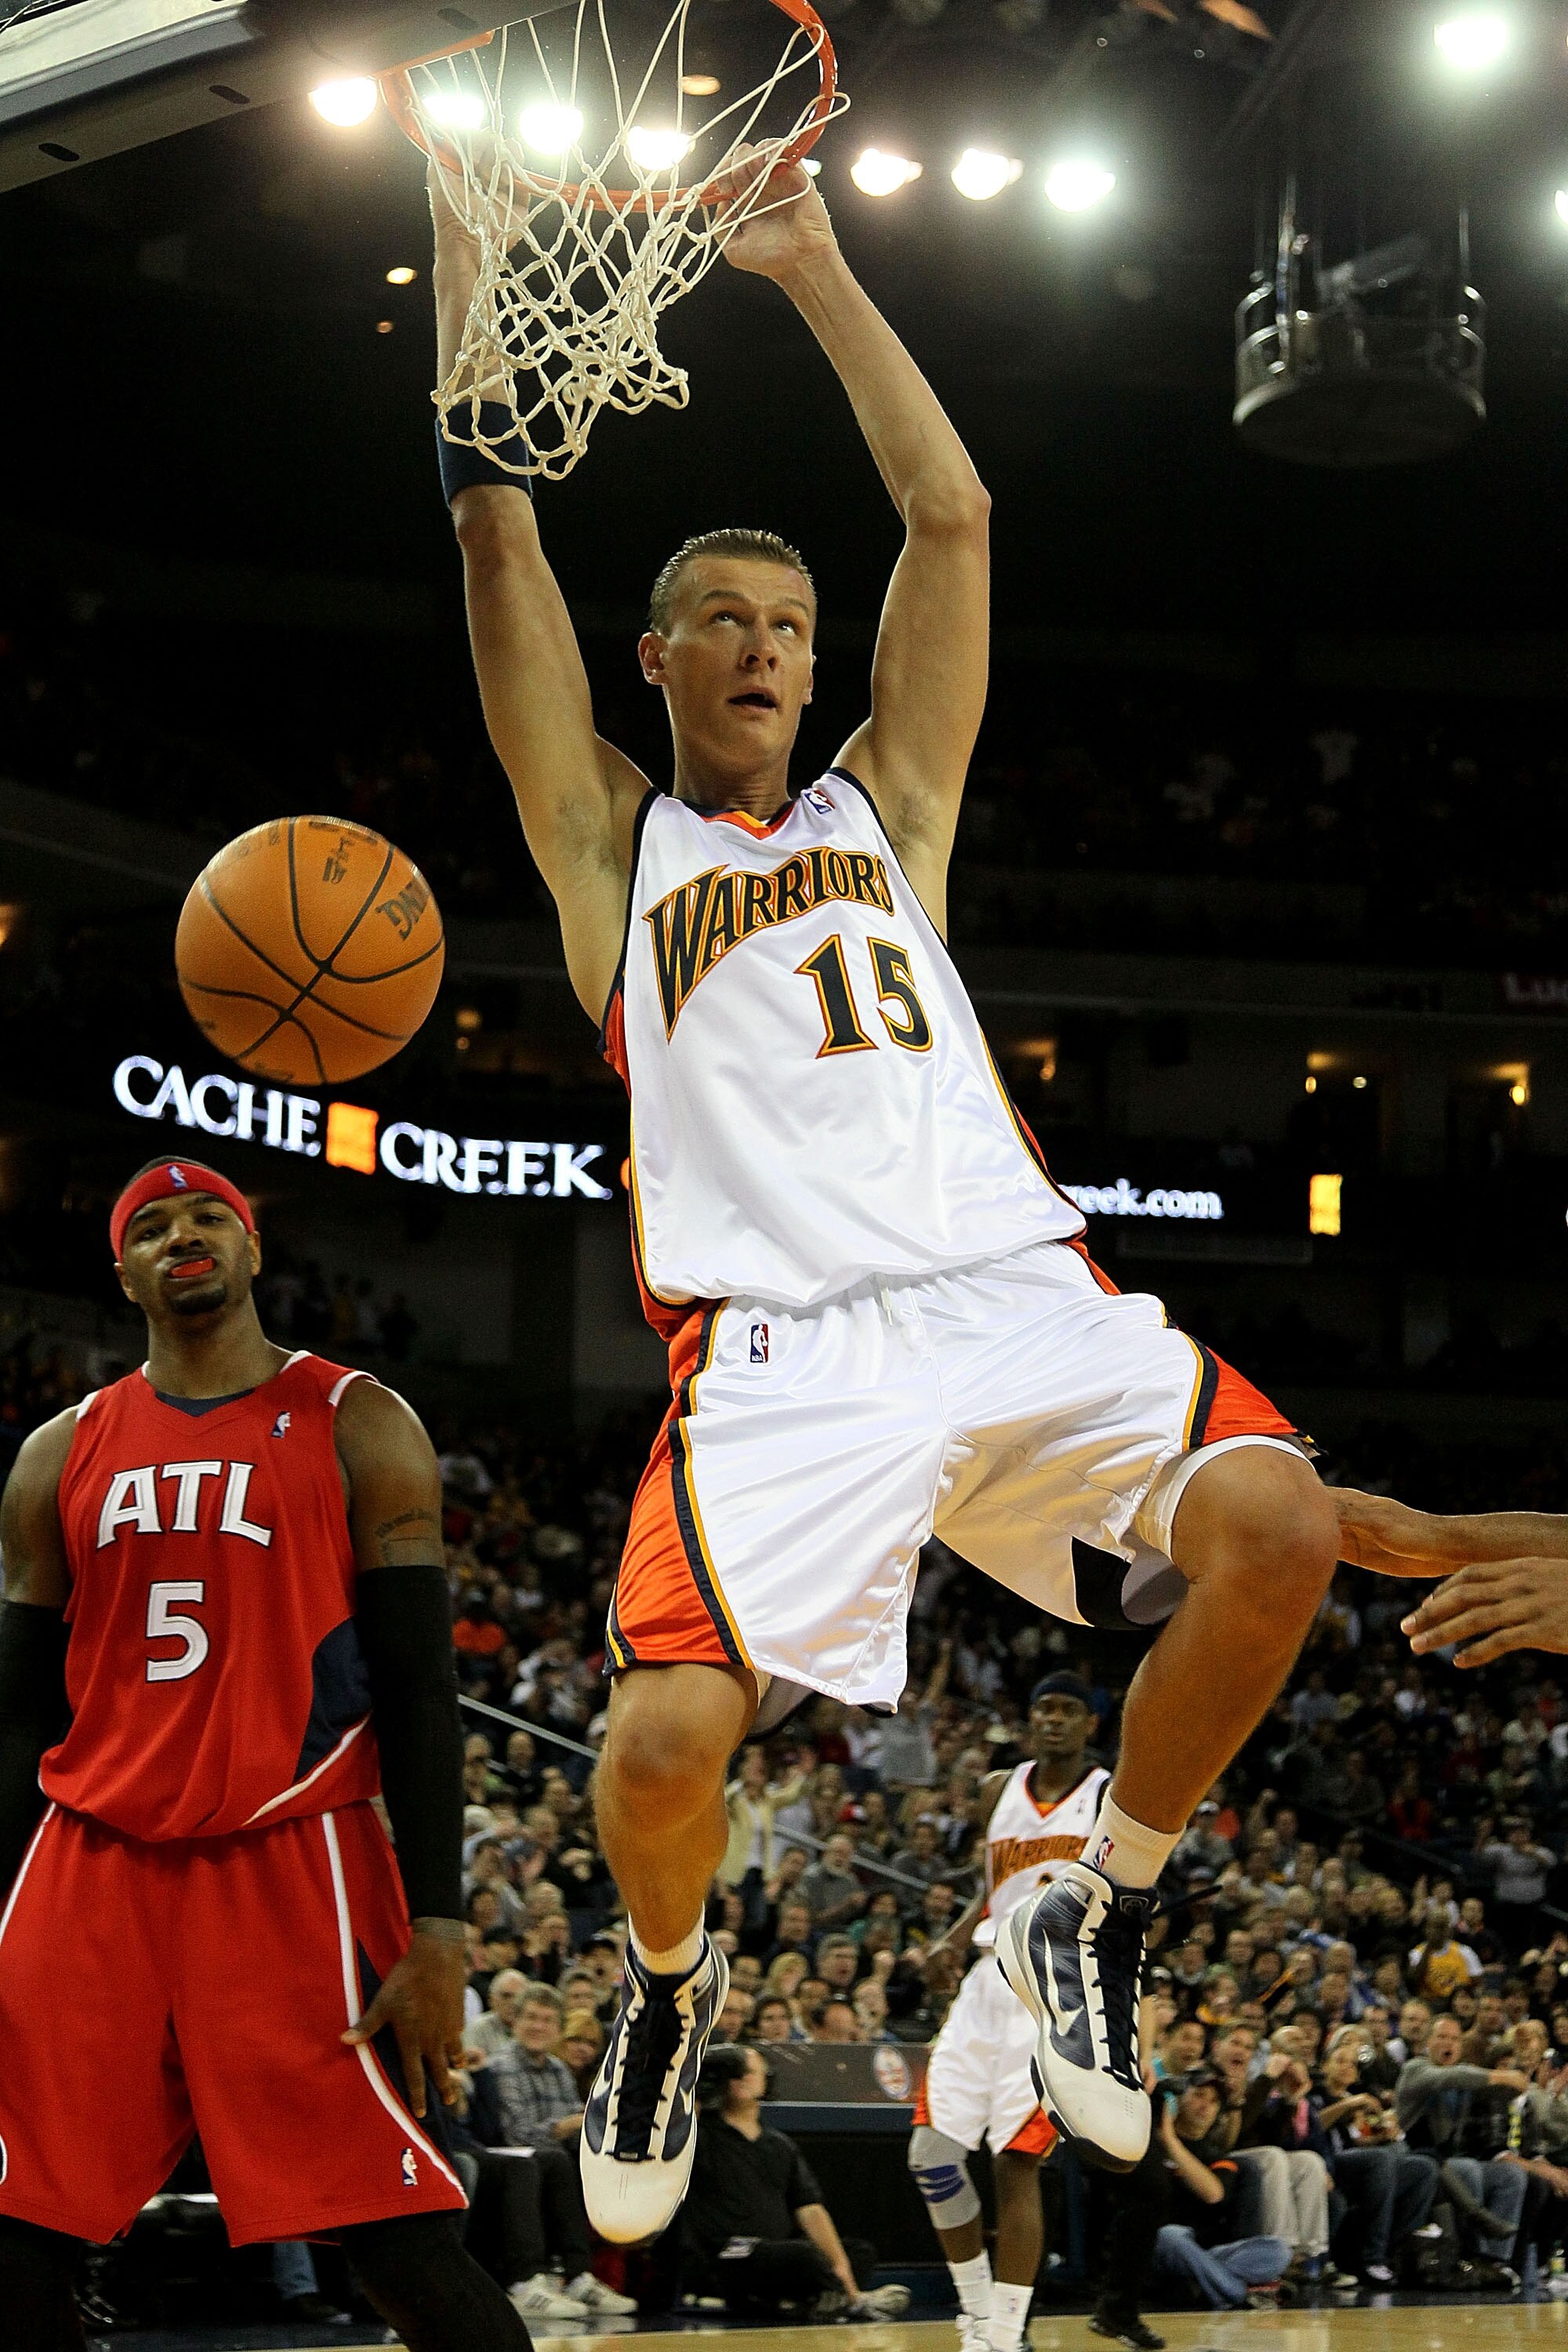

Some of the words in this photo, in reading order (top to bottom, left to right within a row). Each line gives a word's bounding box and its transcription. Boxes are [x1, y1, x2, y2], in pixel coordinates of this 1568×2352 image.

[642, 846, 895, 1045] WARRIORS
[793, 934, 933, 1059] 15
[113, 1055, 321, 1156] CACHE
[379, 1121, 613, 1200] CREEK
[96, 1460, 272, 1553] ATL
[146, 1581, 208, 1682] 5
